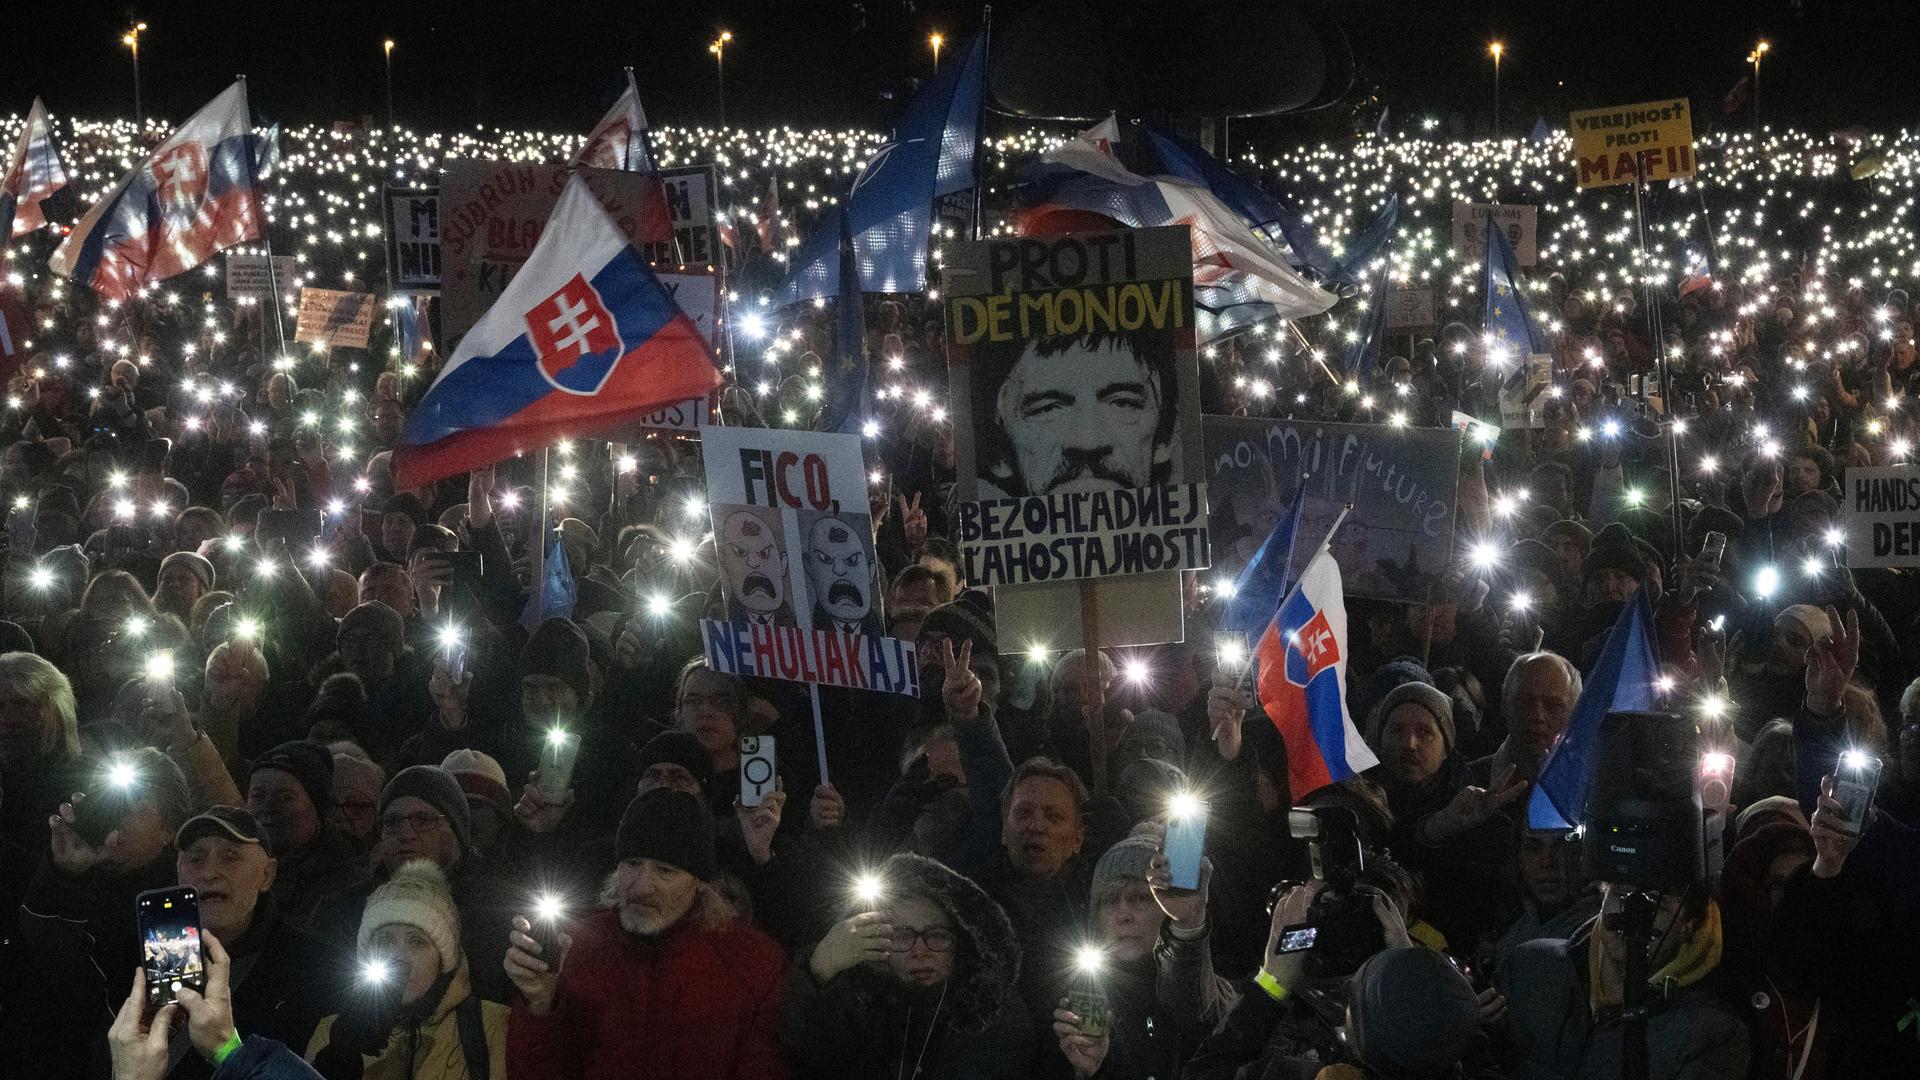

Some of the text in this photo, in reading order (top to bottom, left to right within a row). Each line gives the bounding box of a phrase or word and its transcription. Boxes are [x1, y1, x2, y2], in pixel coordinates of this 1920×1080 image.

[1576, 102, 1684, 131] VEREJNOSŤ
[1606, 129, 1659, 148] PROTI
[1580, 145, 1691, 183] MAFII
[990, 233, 1137, 292] PROTI
[952, 279, 1184, 346] DÉMONOVI
[739, 447, 840, 516] FICO,
[1855, 478, 1920, 513] HANDS
[961, 484, 1198, 542] BEZOHĽADNEJ
[963, 528, 1209, 586] ĽAHOSTAJNOSTI
[707, 620, 918, 698] NEHULIAKAJ!
[1610, 844, 1636, 854] Canon
